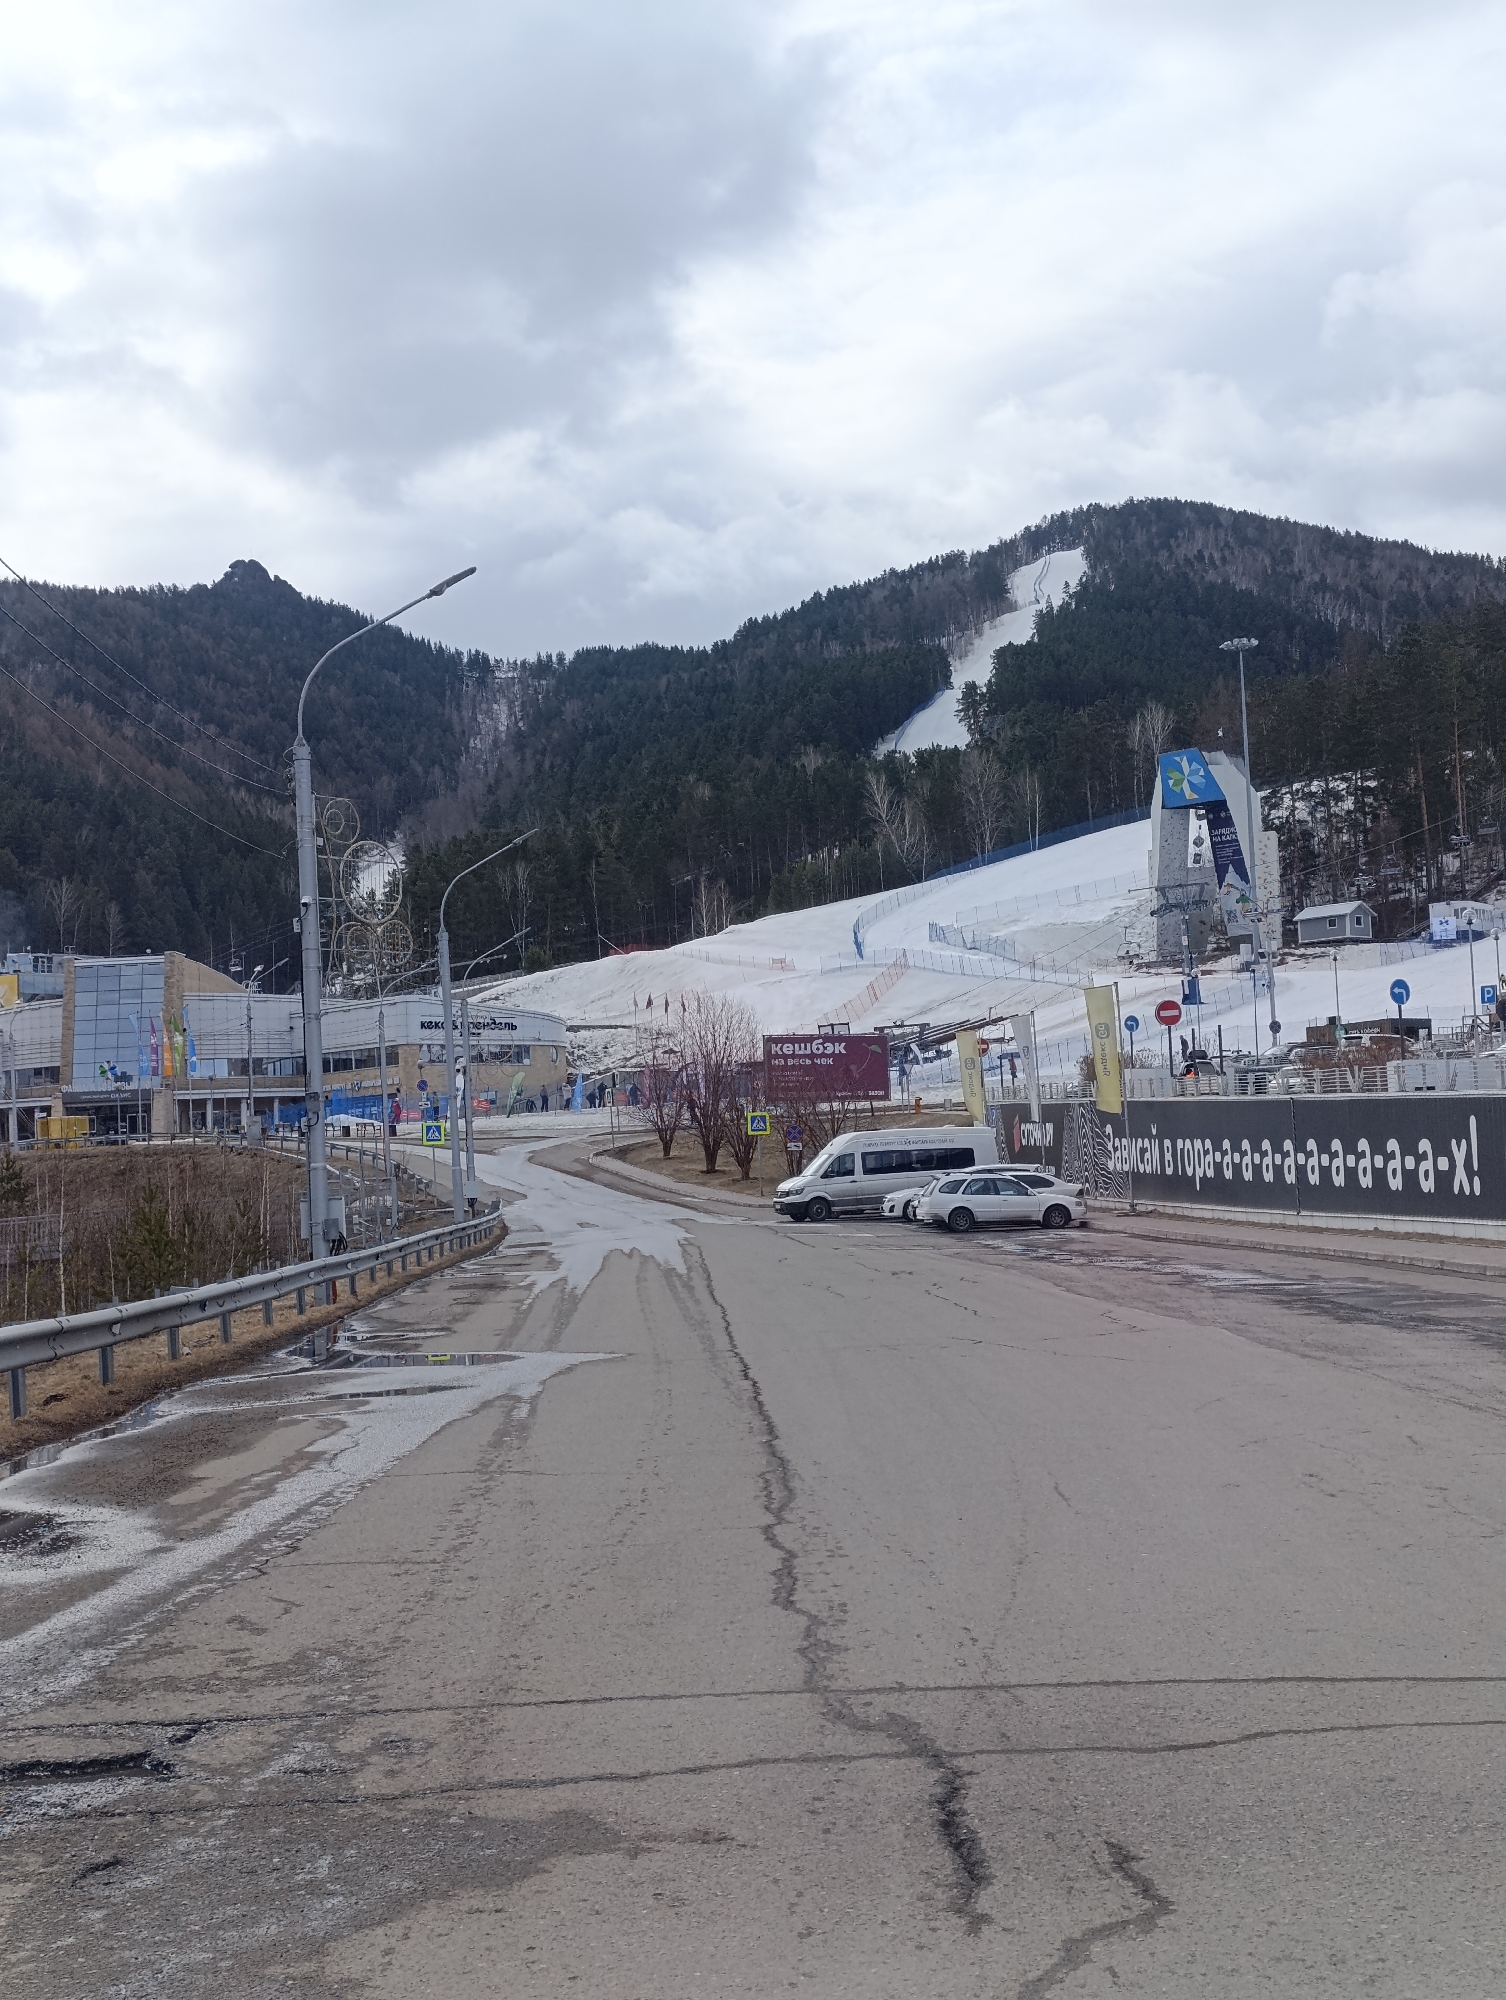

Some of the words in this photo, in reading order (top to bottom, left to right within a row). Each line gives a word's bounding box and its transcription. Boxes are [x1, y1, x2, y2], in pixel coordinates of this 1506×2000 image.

[771, 1039, 846, 1055] кешбэк
[787, 1058, 812, 1066] весь
[814, 1057, 834, 1065] чек
[1106, 1123, 1160, 1175] Зависай
[1163, 1138, 1173, 1175] в
